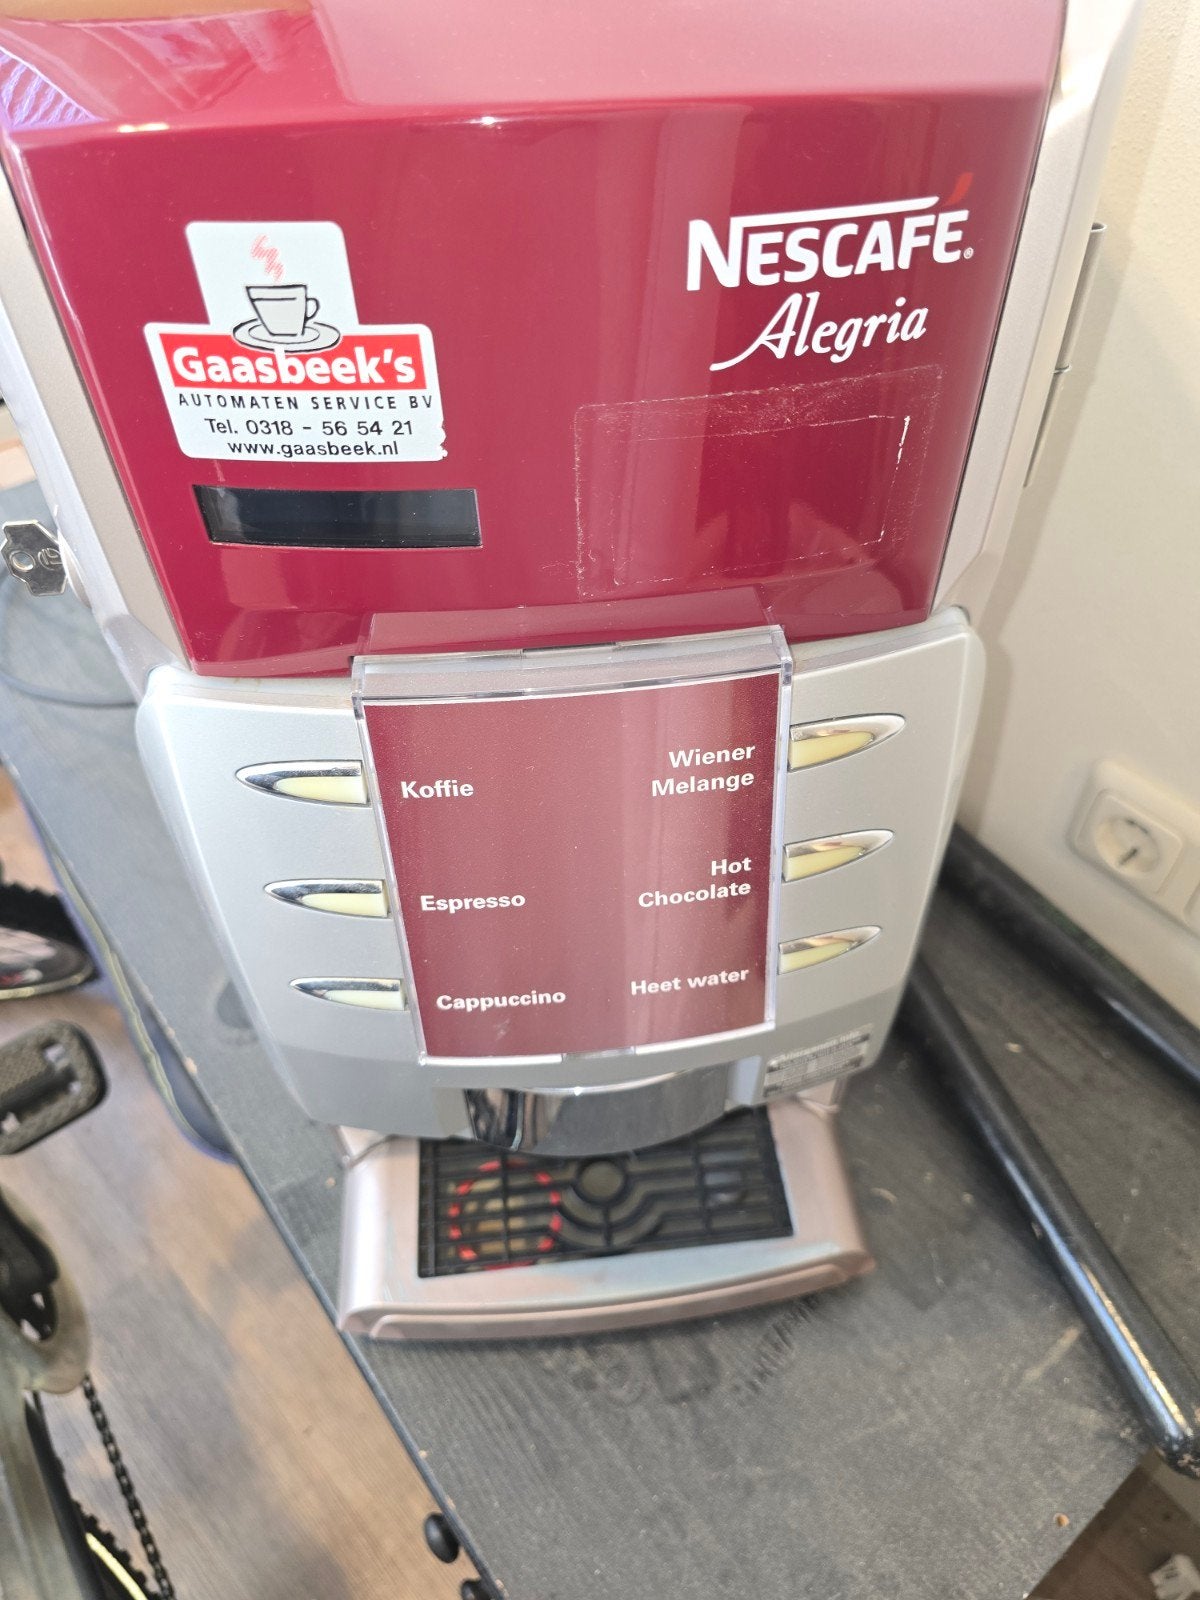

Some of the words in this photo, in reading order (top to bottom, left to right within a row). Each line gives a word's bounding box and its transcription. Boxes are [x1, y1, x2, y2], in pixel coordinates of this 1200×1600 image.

[709, 291, 929, 371] Alegria
[172, 345, 416, 384] Gaasbeek's
[178, 393, 299, 410] AUTOMATEN
[311, 395, 397, 410] SERVICE
[409, 394, 433, 409] BV
[204, 418, 238, 434] Tel.
[245, 419, 293, 436] 0318
[322, 421, 348, 437] 56
[357, 420, 383, 436] 54
[392, 420, 413, 435] 21
[227, 441, 399, 458] www.gaasbeek.nl
[668, 746, 756, 769] Wiener
[400, 779, 474, 798] Koffie
[651, 772, 755, 797] Melange
[711, 857, 752, 876] Hot
[420, 895, 526, 913] Espresso
[638, 882, 752, 908] Chocolate
[630, 976, 682, 996] Heet
[687, 968, 750, 989] water
[436, 990, 567, 1012] Cappuccino
